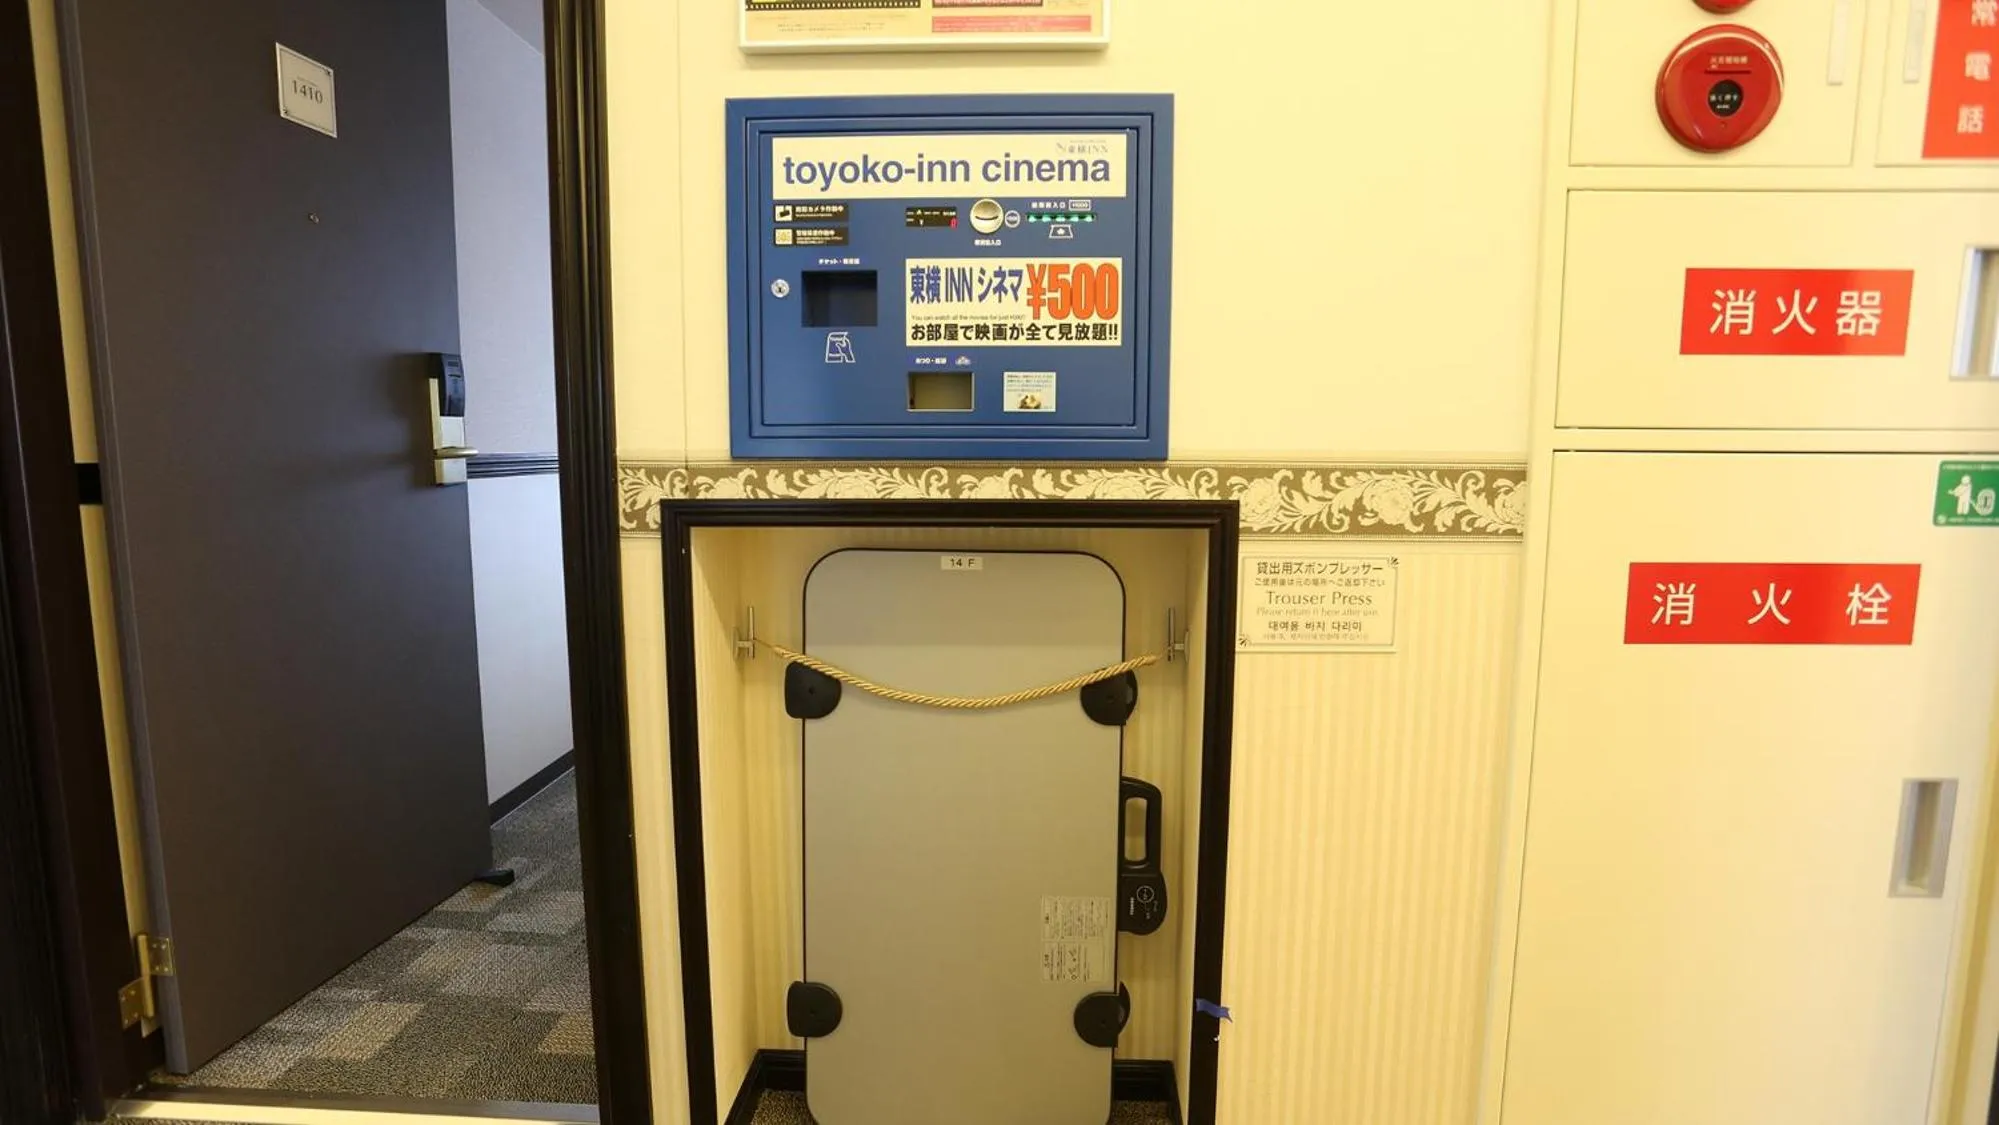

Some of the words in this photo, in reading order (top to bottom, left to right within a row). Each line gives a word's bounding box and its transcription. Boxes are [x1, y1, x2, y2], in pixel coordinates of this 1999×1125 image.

[292, 79, 324, 105] 1410
[783, 152, 971, 192] toyoko-inn
[981, 152, 1111, 183] cinema
[910, 264, 942, 305] 東横
[944, 266, 973, 303] INN
[977, 265, 1024, 304] シネマ
[1025, 262, 1119, 321] ¥500
[1709, 288, 1883, 337] 消火器
[911, 322, 1118, 342] お部屋で映画が全て見放題!!
[949, 558, 963, 568] 14
[1266, 591, 1326, 605] Trouser
[1332, 591, 1373, 605] Press
[1651, 582, 1893, 626] 消火栓
[1332, 620, 1362, 632] 다리미
